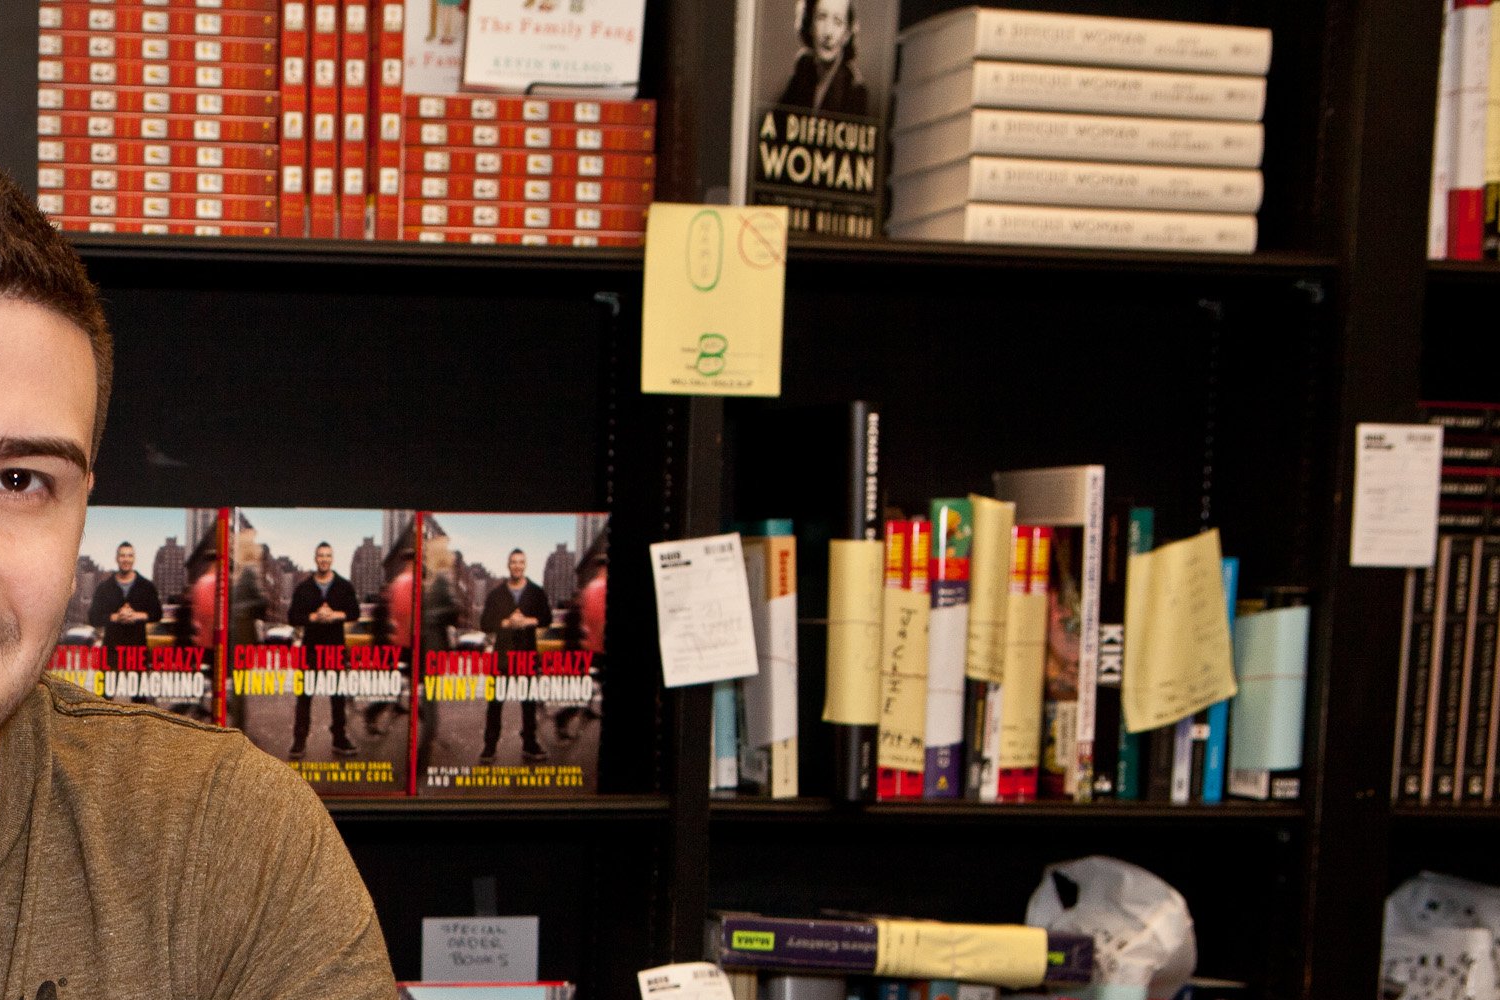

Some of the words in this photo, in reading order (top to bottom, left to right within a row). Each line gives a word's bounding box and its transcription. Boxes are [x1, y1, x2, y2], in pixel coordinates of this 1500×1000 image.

[519, 16, 583, 41] Family
[589, 20, 636, 45] Fang
[760, 111, 778, 140] A
[785, 113, 878, 153] DIFFICULT
[759, 140, 876, 192] WOMAN
[116, 645, 147, 671] THE
[152, 645, 205, 671] CRAZY
[233, 644, 309, 670] CONTROL
[315, 645, 345, 670] THE
[351, 645, 401, 671] CRAZY
[425, 650, 500, 676] CONTROL
[506, 651, 537, 676] THE
[542, 651, 594, 676] CRAZY
[1099, 623, 1124, 685] KIKI
[94, 670, 205, 698] GUADAGNINO
[232, 669, 287, 696] VINNY
[293, 670, 402, 697] GUADAGNINO
[424, 674, 477, 702] VINNY
[484, 674, 594, 702] GUADAGNINO
[327, 771, 362, 783] INNER
[367, 772, 394, 784] COOL
[427, 776, 451, 788] AND
[455, 776, 512, 788] MAINTAIN
[516, 776, 551, 788] INNER
[556, 776, 584, 788] COOL
